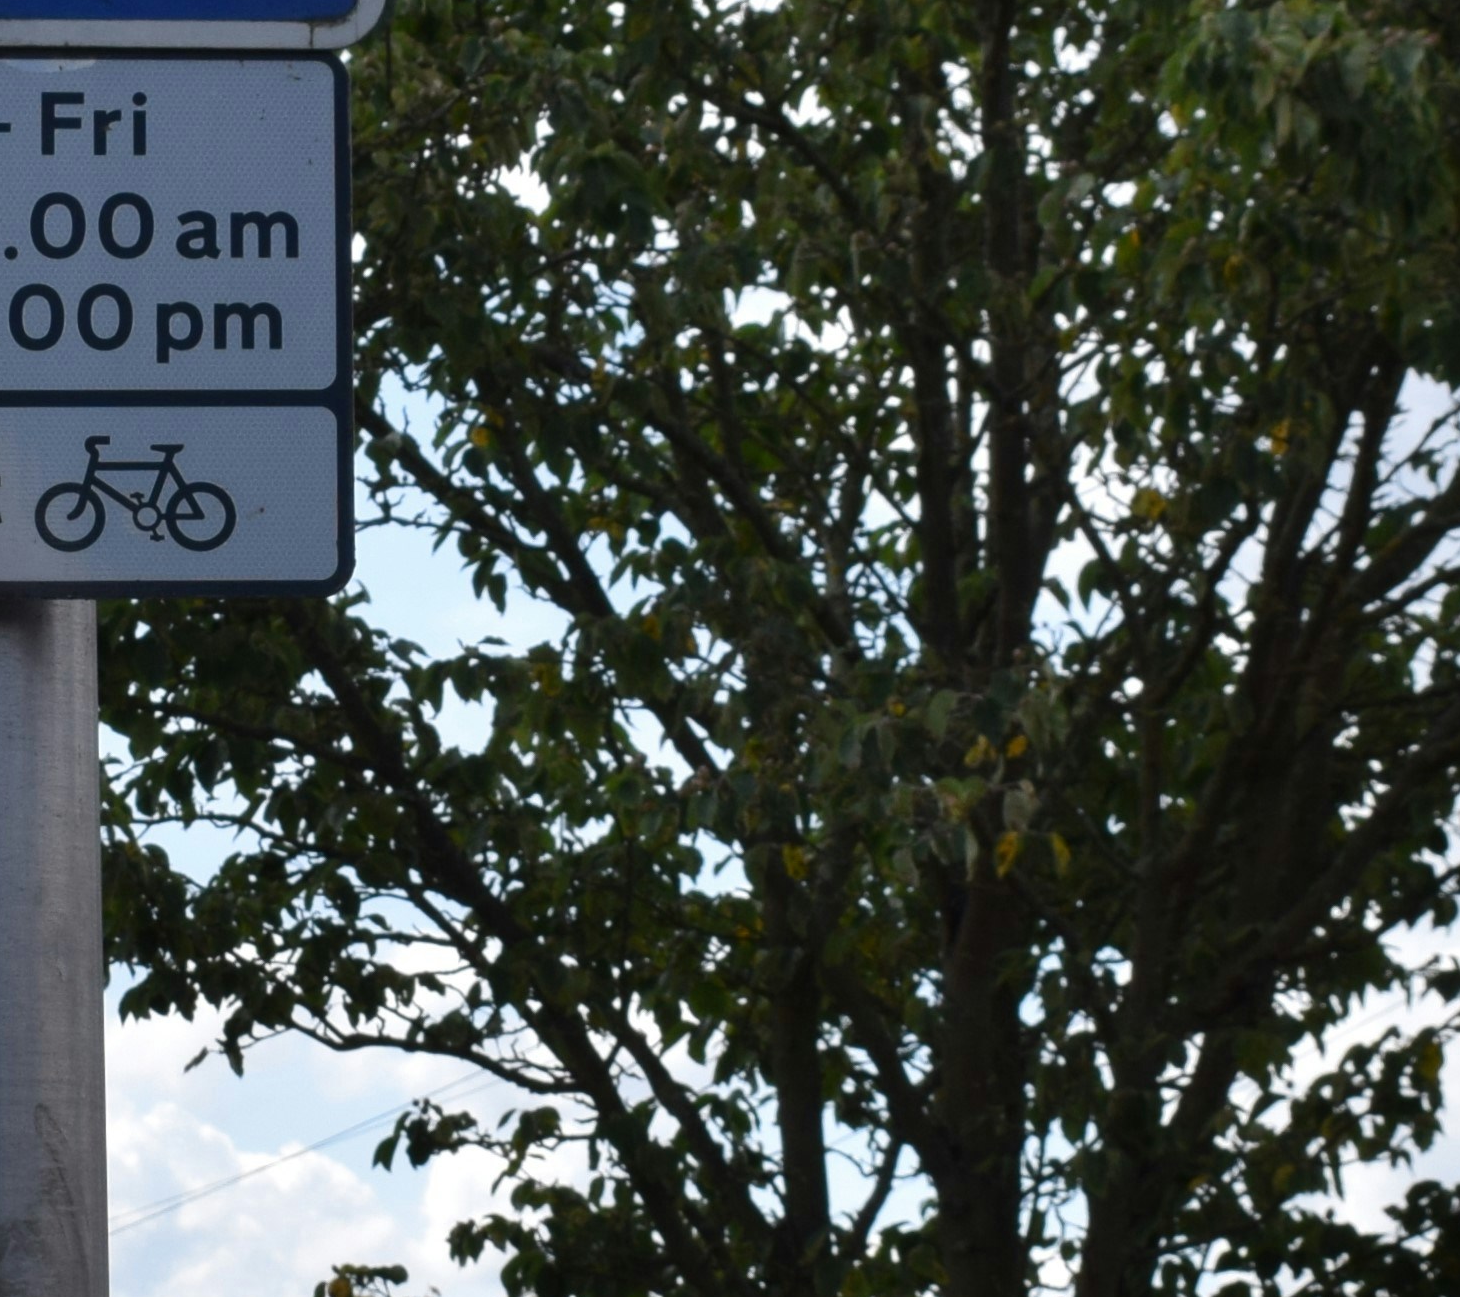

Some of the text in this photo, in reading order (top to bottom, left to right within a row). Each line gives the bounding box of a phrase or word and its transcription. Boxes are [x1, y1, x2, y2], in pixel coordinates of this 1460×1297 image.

[40, 91, 149, 157] Fri
[175, 209, 301, 261] am
[156, 301, 284, 364] pm
